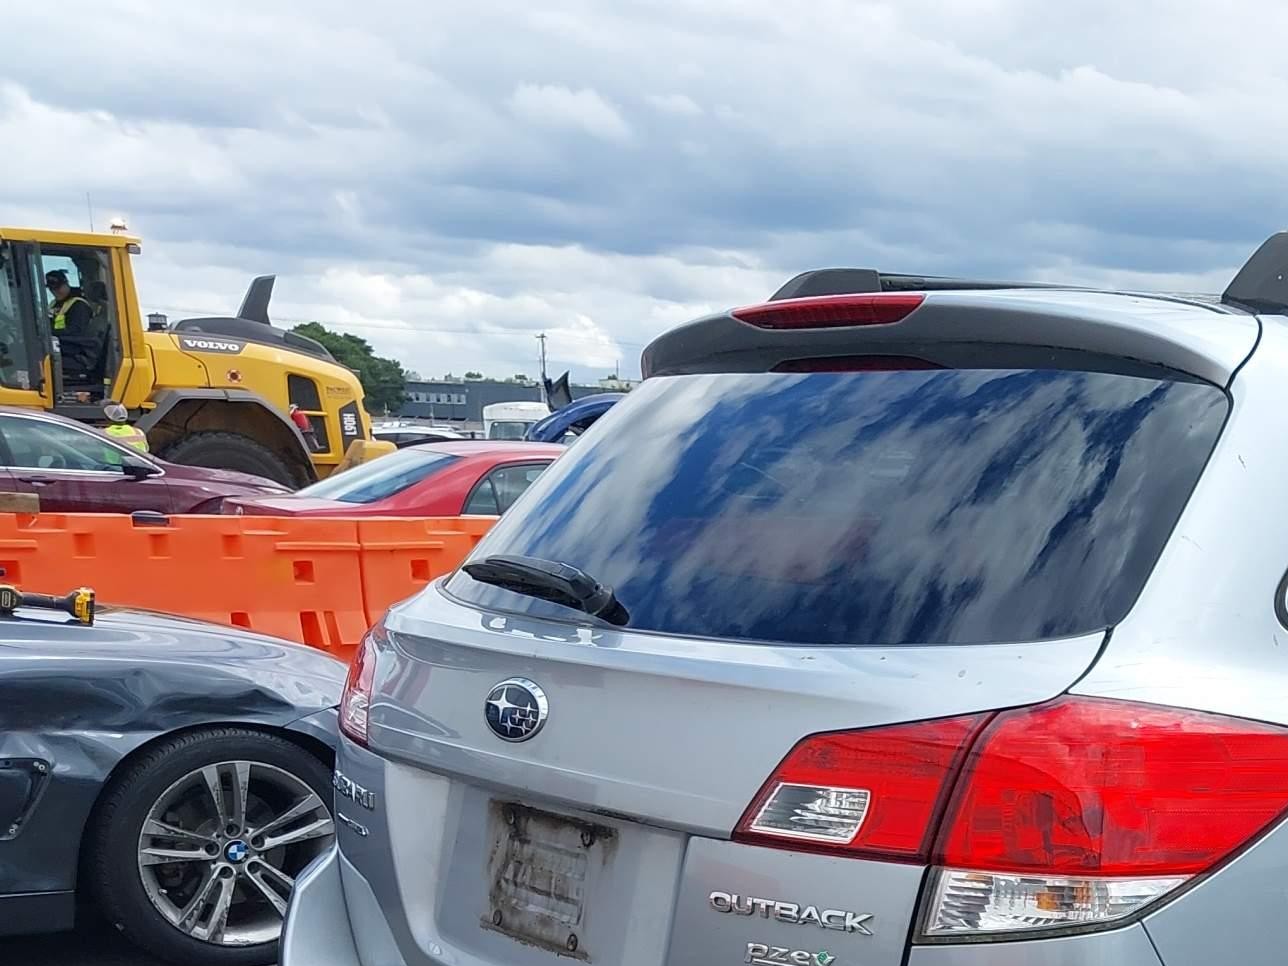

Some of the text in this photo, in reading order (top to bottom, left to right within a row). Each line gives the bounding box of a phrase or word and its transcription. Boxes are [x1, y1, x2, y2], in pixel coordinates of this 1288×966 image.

[183, 339, 240, 351] VOLVO
[342, 412, 357, 436] L90H
[708, 891, 874, 936] OUTBACK
